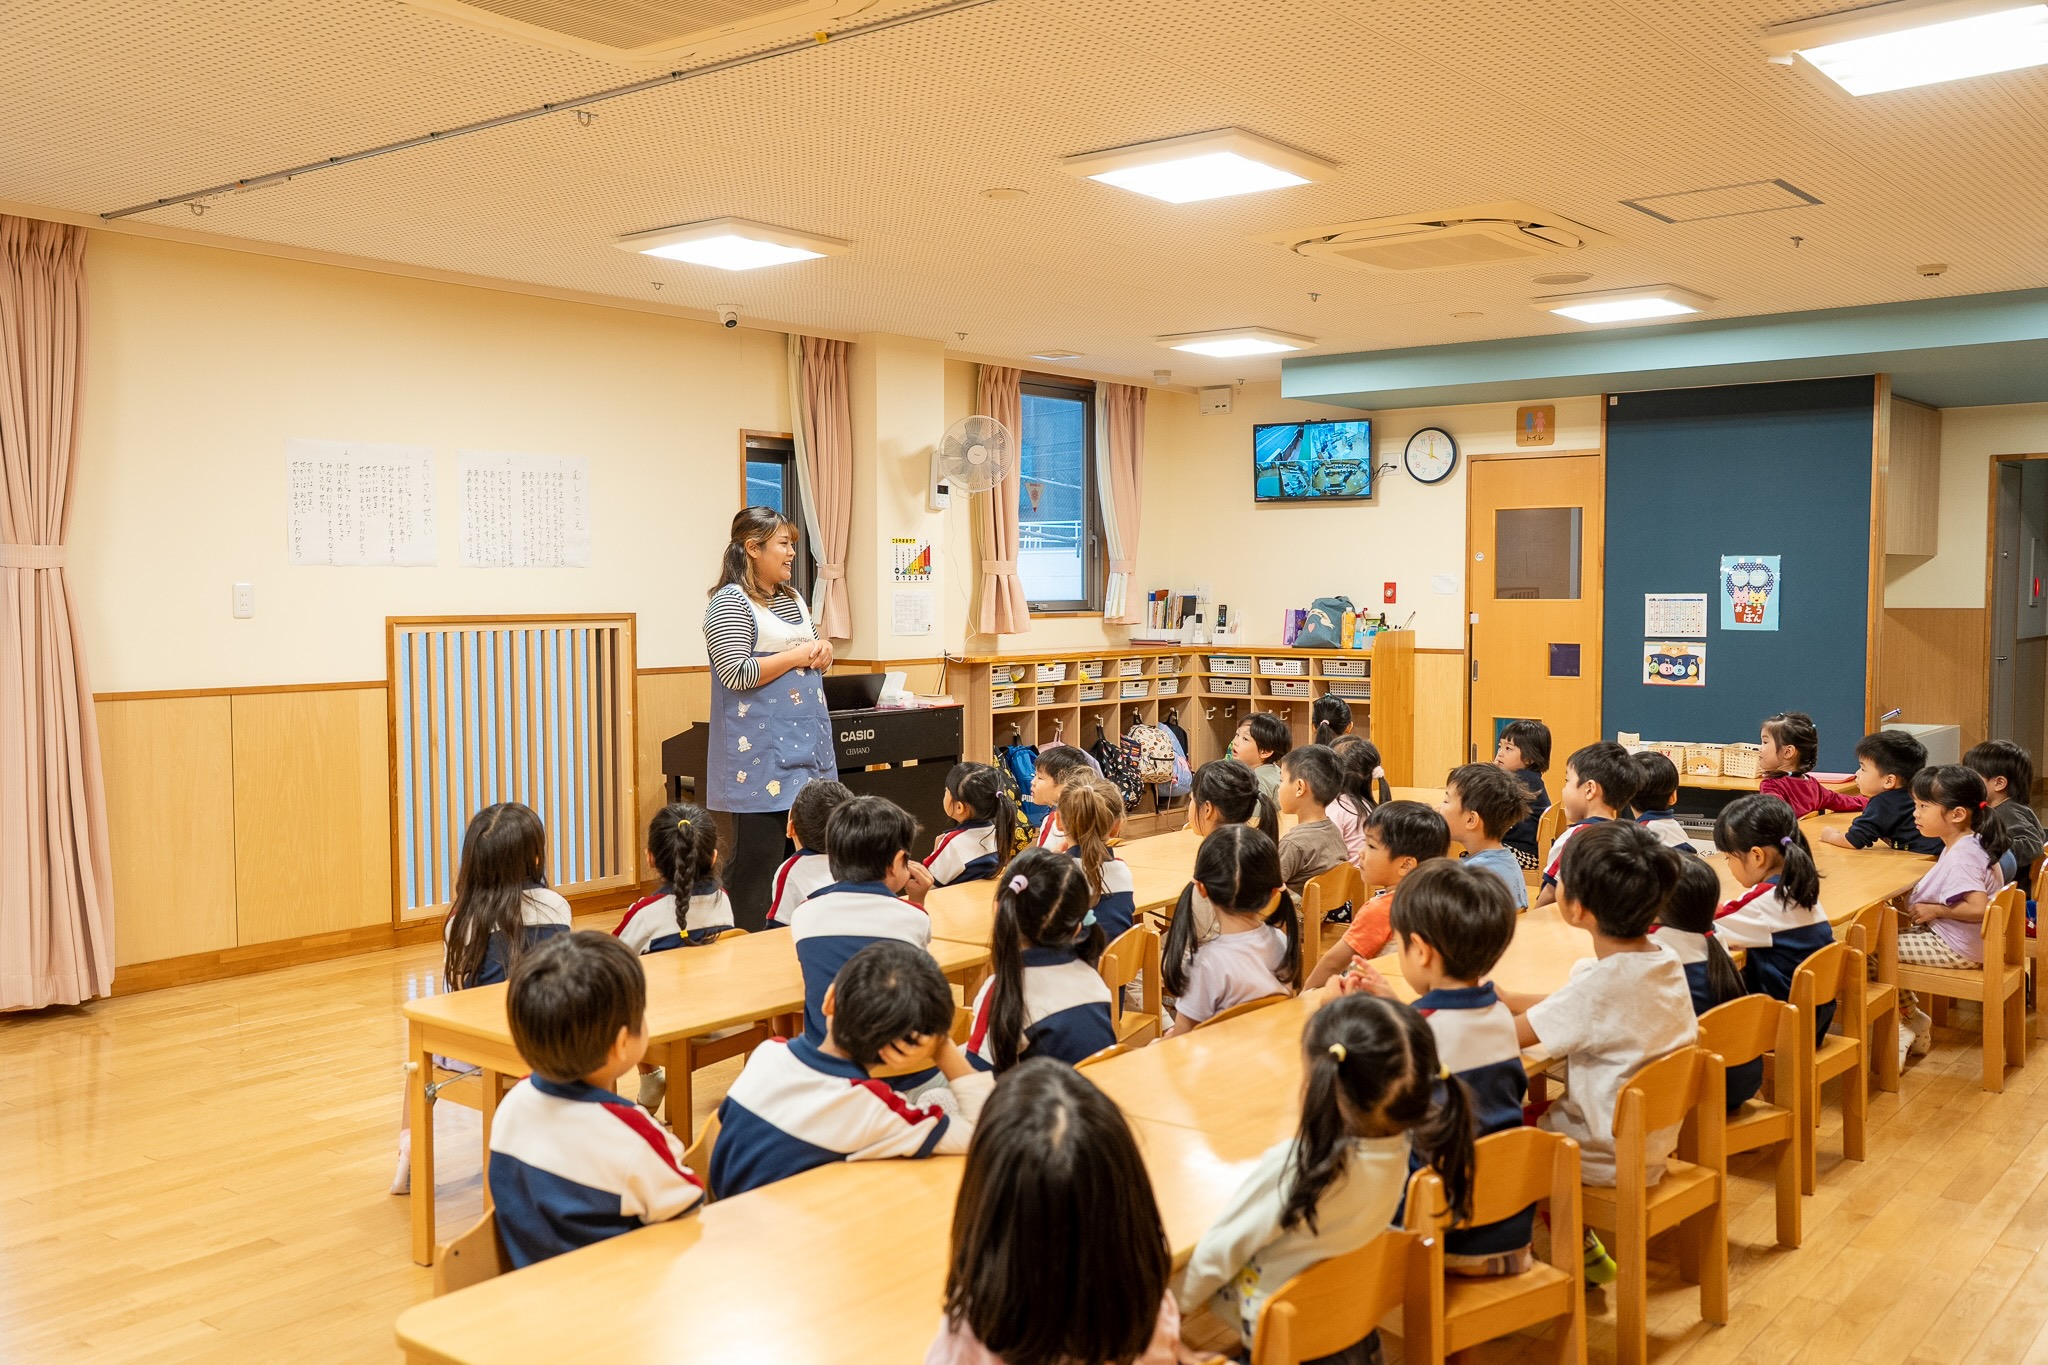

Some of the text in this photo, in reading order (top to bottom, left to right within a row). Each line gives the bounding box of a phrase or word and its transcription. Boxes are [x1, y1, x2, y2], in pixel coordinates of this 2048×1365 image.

[1428, 434, 1435, 442] 12
[1526, 434, 1544, 442] トイレ
[1411, 453, 1418, 461] 9
[1446, 450, 1452, 458] 3
[1415, 461, 1421, 469] 8
[1442, 459, 1449, 467] 4
[1436, 466, 1443, 474] 5
[573, 469, 584, 531] むしのこえ
[1734, 604, 1763, 615] おとう
[1743, 613, 1762, 623] ばん
[840, 729, 875, 742] CASIO
[845, 746, 870, 756] CELVIANO
